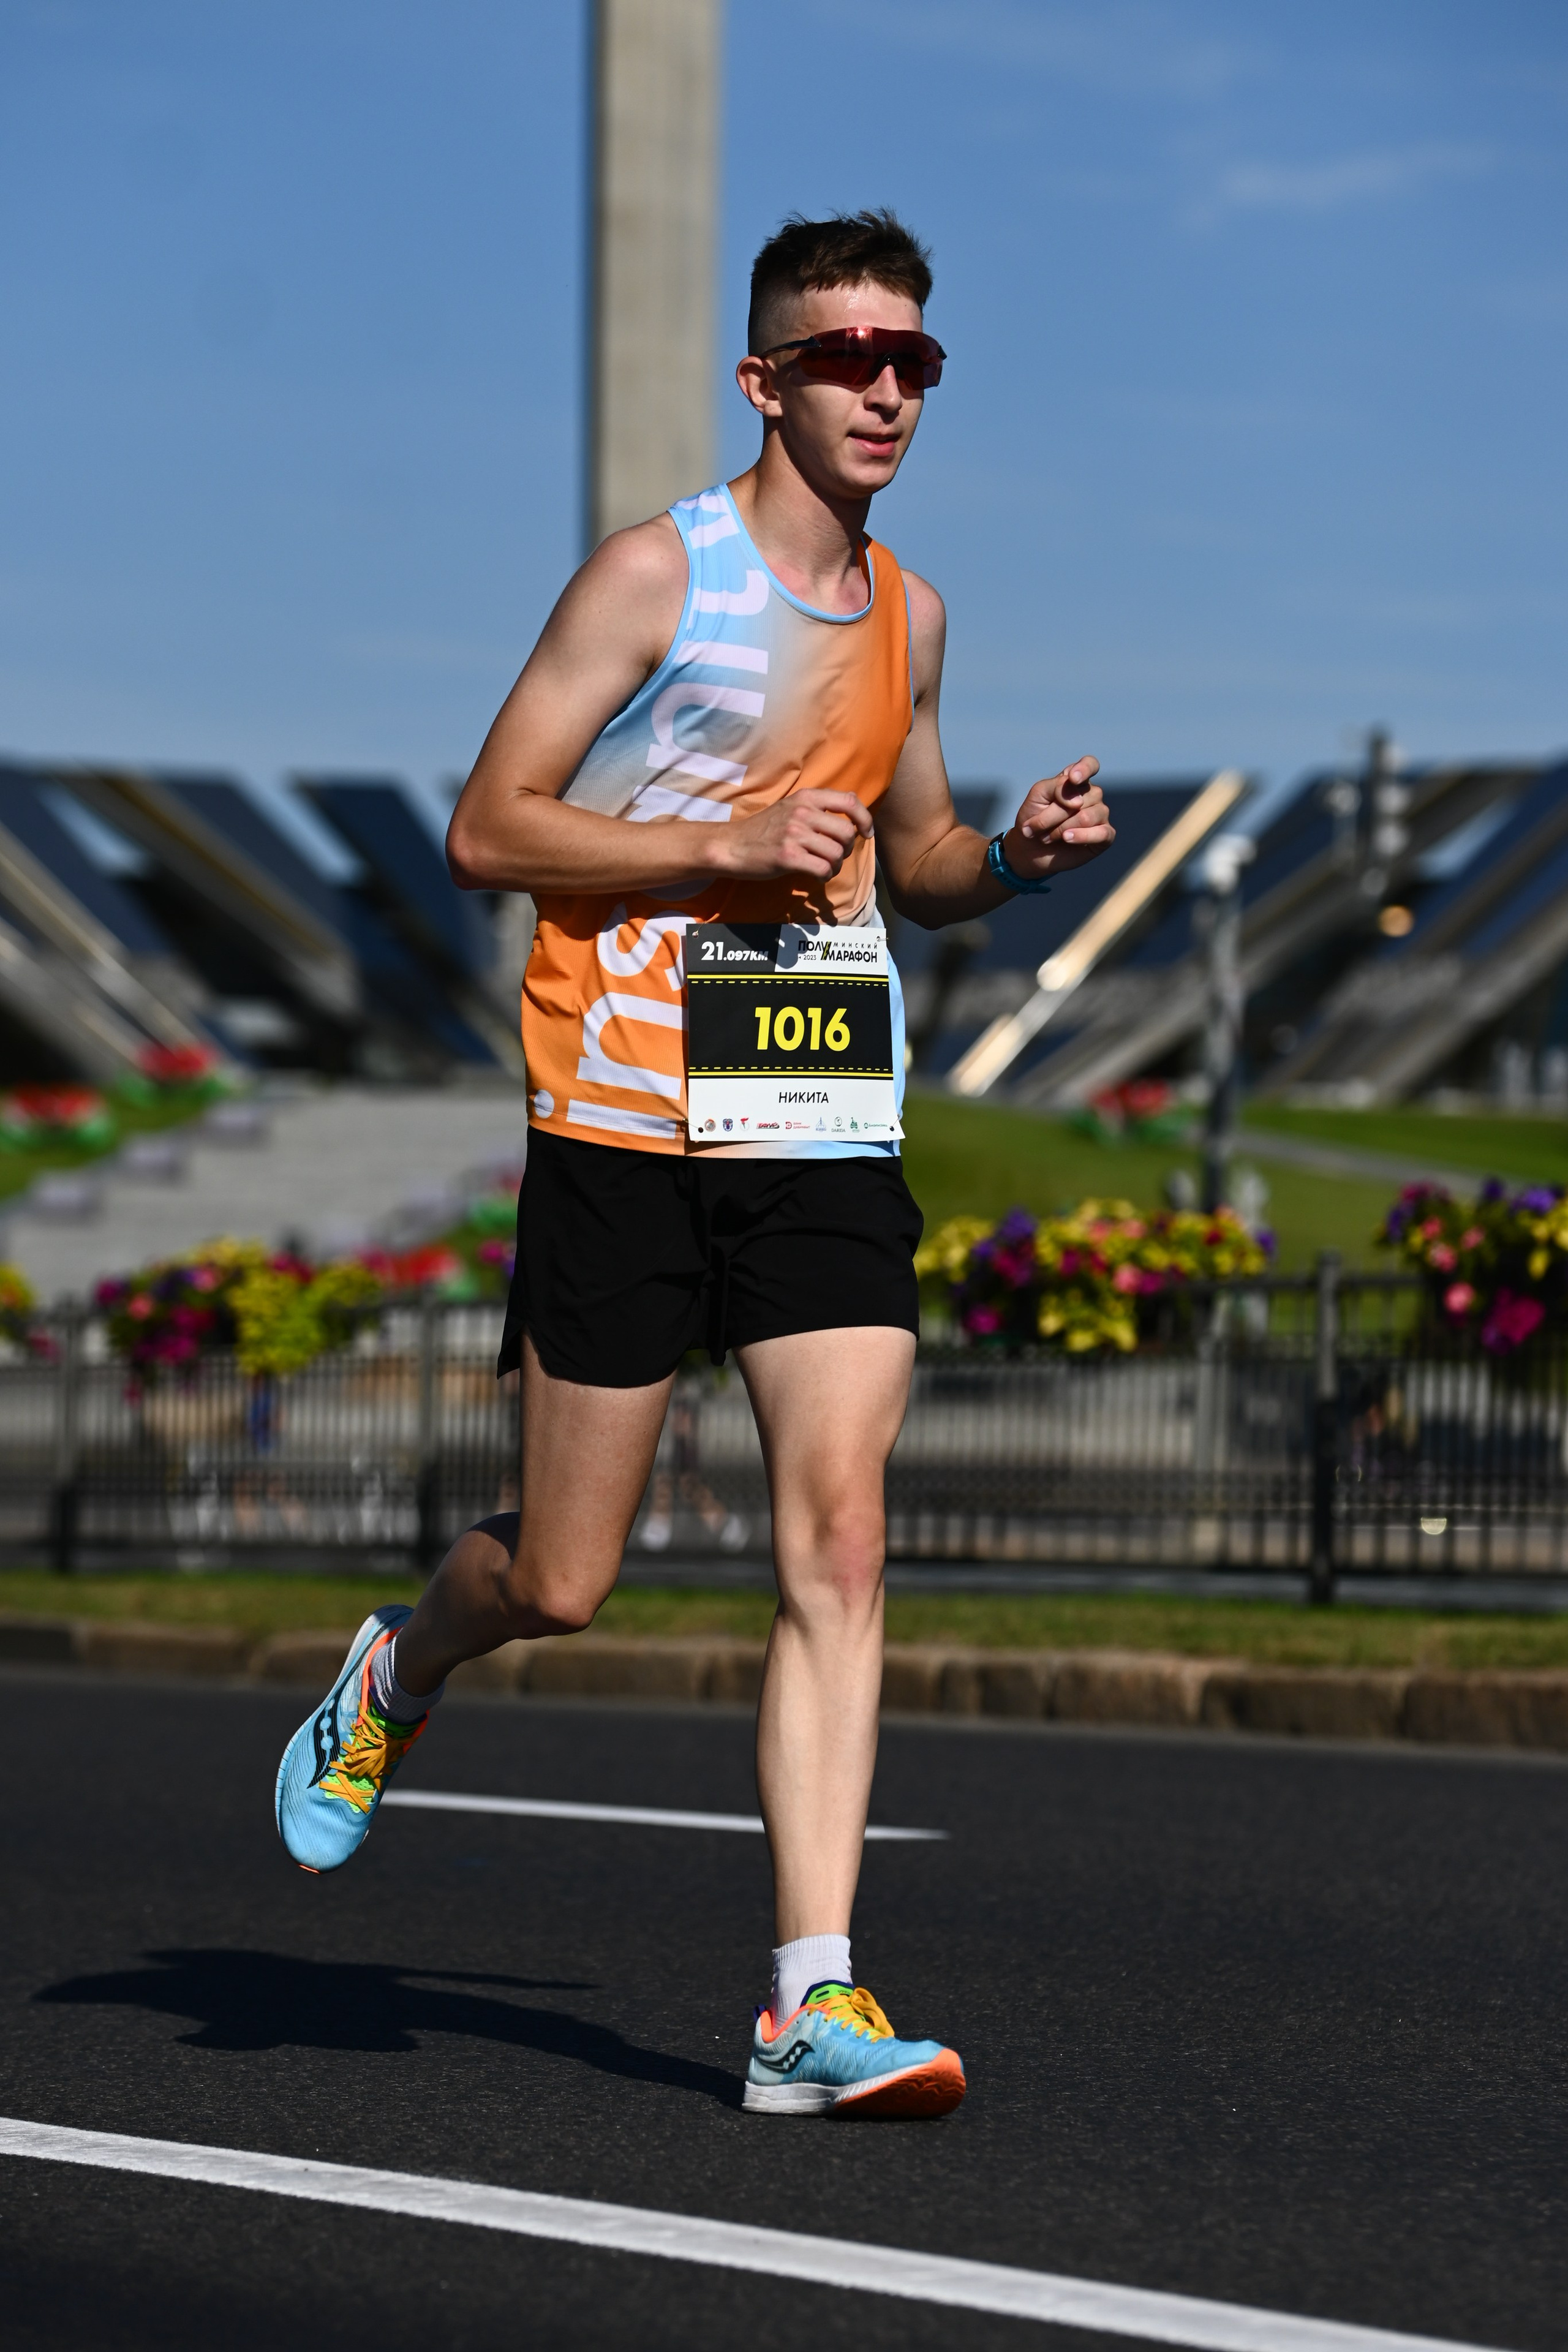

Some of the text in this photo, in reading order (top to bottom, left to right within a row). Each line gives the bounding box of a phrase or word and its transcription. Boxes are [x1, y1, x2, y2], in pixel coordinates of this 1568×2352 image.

[798, 940, 831, 959] ПОЛУ
[825, 949, 877, 963] МАРАФОН
[755, 1006, 851, 1052] 1016
[778, 1091, 829, 1104] НИКИТА
